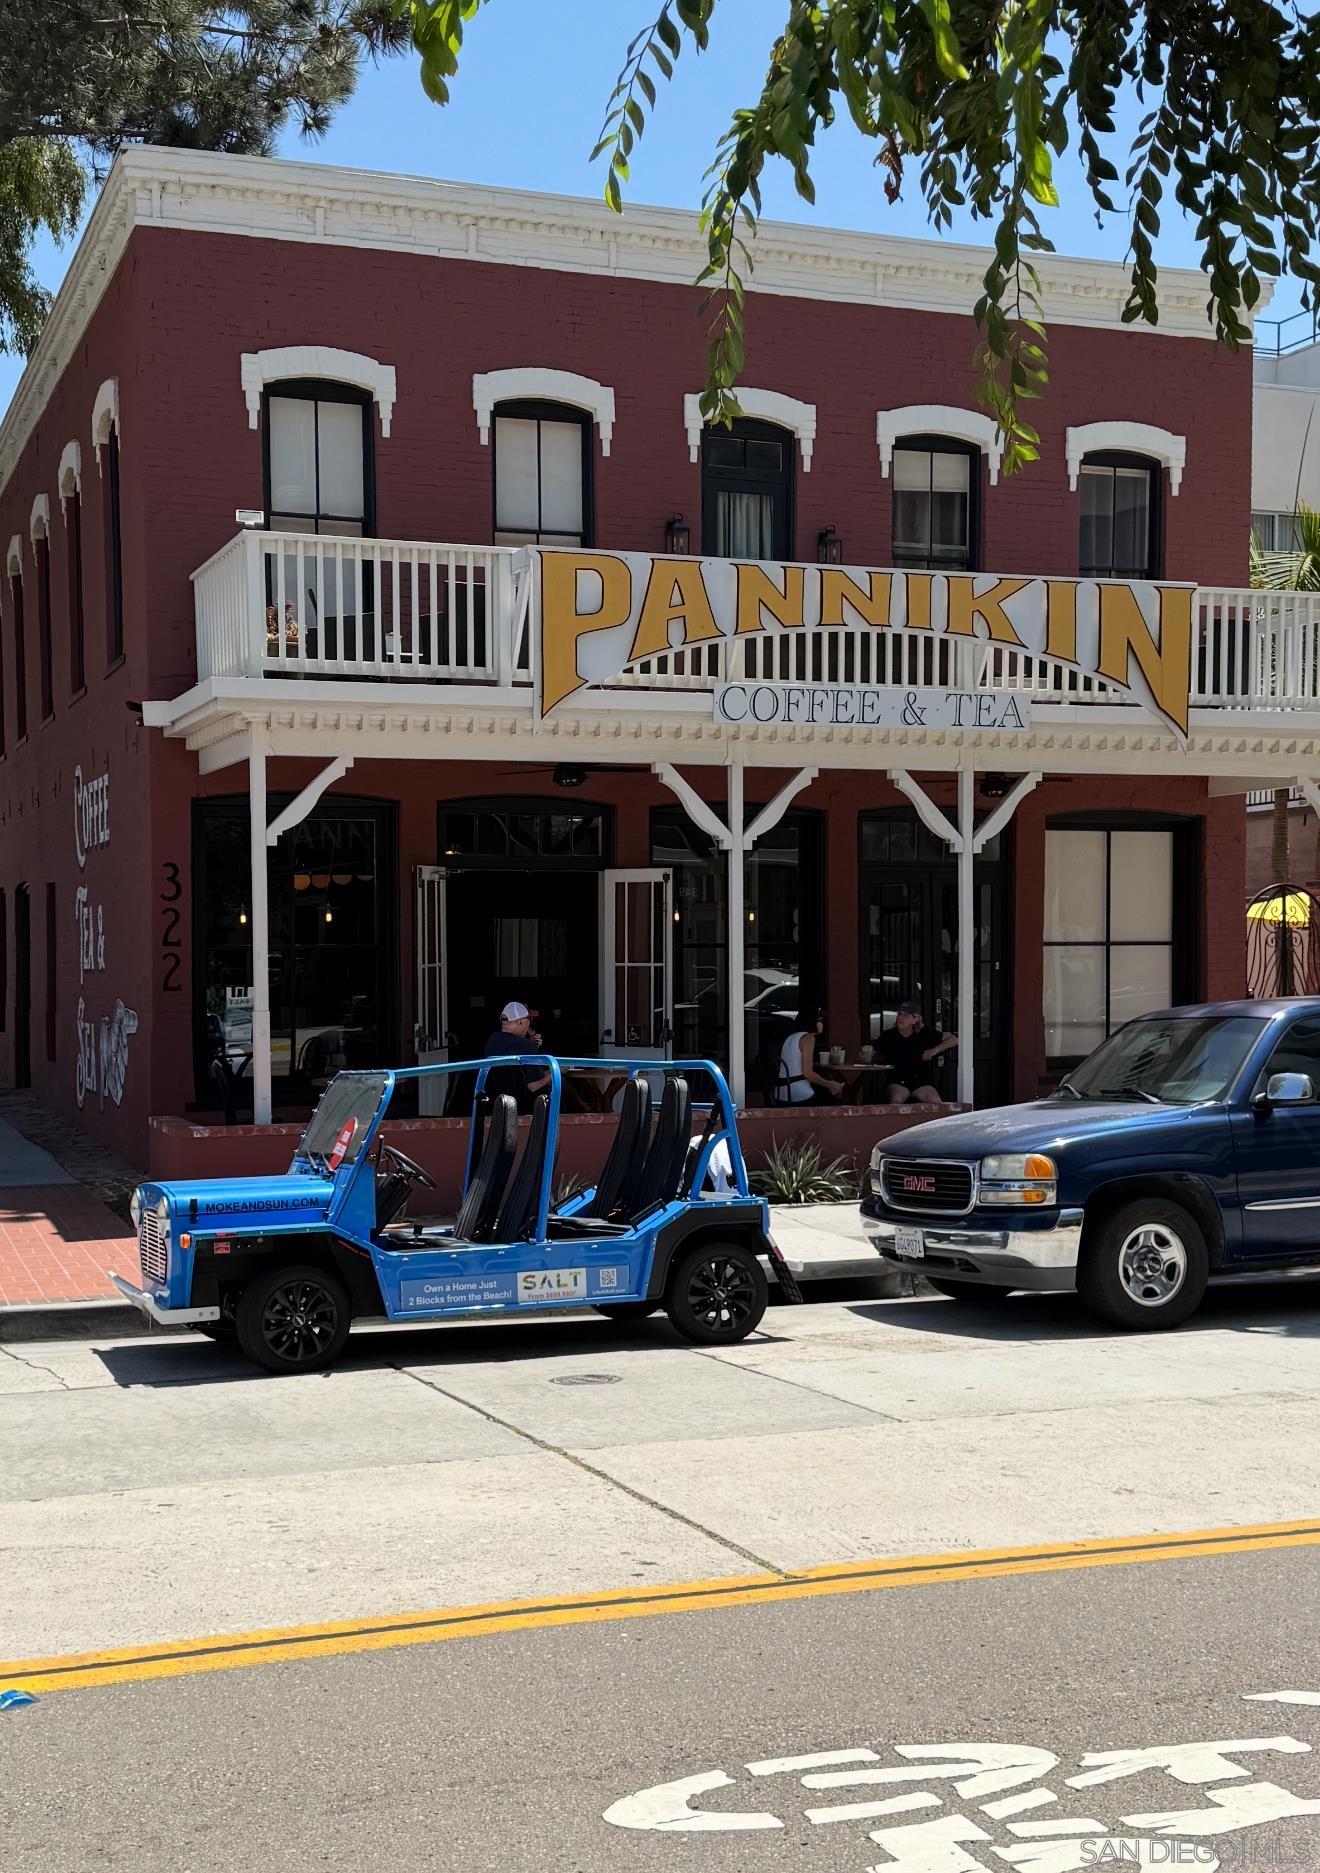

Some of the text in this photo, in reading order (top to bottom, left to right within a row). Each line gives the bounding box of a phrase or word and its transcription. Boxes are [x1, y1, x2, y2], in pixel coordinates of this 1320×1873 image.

[539, 549, 1195, 738] PANNIKIN
[716, 684, 1026, 730] COFFEE & TEA
[97, 905, 106, 969] &
[903, 1175, 935, 1192] GMC
[205, 1197, 319, 1214] MOKEANDSUN.COM
[423, 1283, 445, 1294] Own
[452, 1281, 478, 1292] Home
[478, 1279, 498, 1290] Just
[522, 1270, 582, 1292] SALT
[408, 1289, 512, 1306] 2 Blocks from the Beach!
[527, 1292, 545, 1301] From
